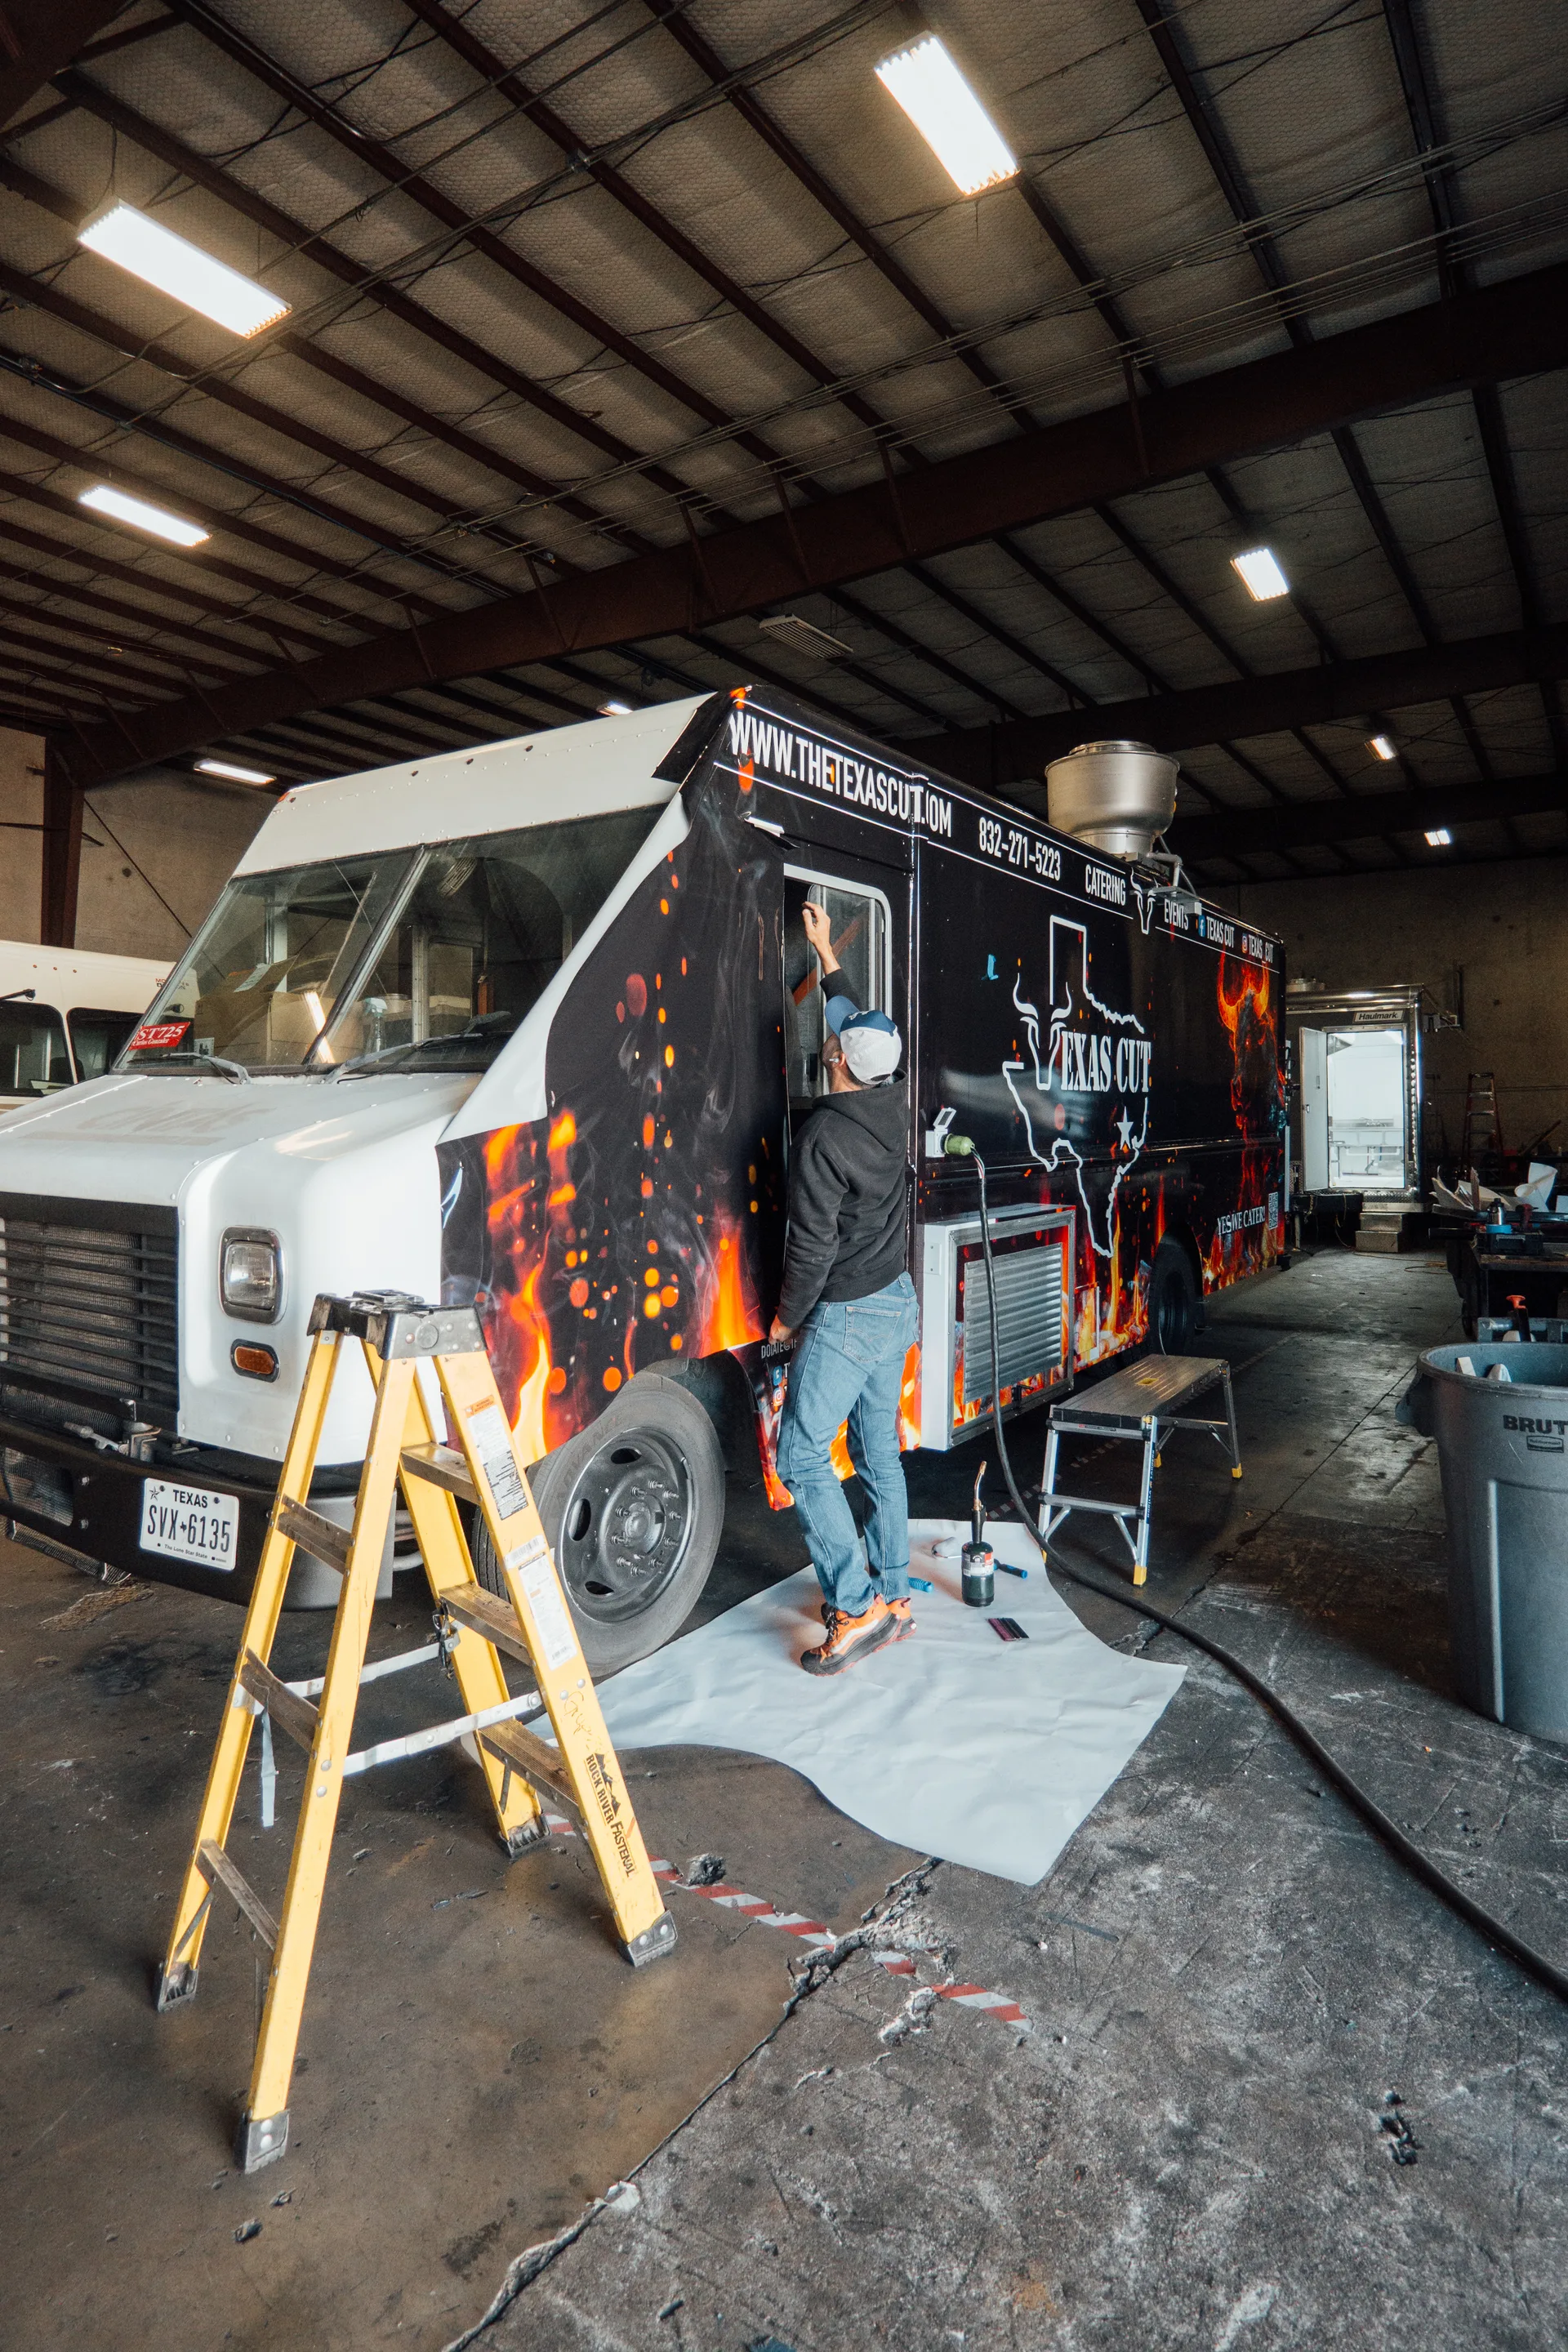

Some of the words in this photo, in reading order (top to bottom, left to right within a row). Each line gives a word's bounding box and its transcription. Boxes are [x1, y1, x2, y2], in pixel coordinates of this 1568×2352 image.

[979, 817, 1061, 881] 832-271-5223
[1085, 864, 1126, 906] CATERING
[1164, 898, 1189, 930] EVENTS
[1206, 916, 1223, 944] TEXAS
[1224, 924, 1235, 948] CUT
[1358, 1012, 1398, 1020] Haulmark
[1116, 1037, 1152, 1094] CUT
[1217, 1215, 1232, 1236] YES
[1232, 1212, 1243, 1232] WE
[1243, 1205, 1266, 1227] CATER!
[172, 1489, 208, 1508] TEXAS
[185, 1548, 195, 1557] Star
[195, 1551, 207, 1559] State
[586, 1753, 603, 1788] ROCK
[597, 1788, 615, 1825] RIVER
[610, 1820, 636, 1878] FASTENAL
